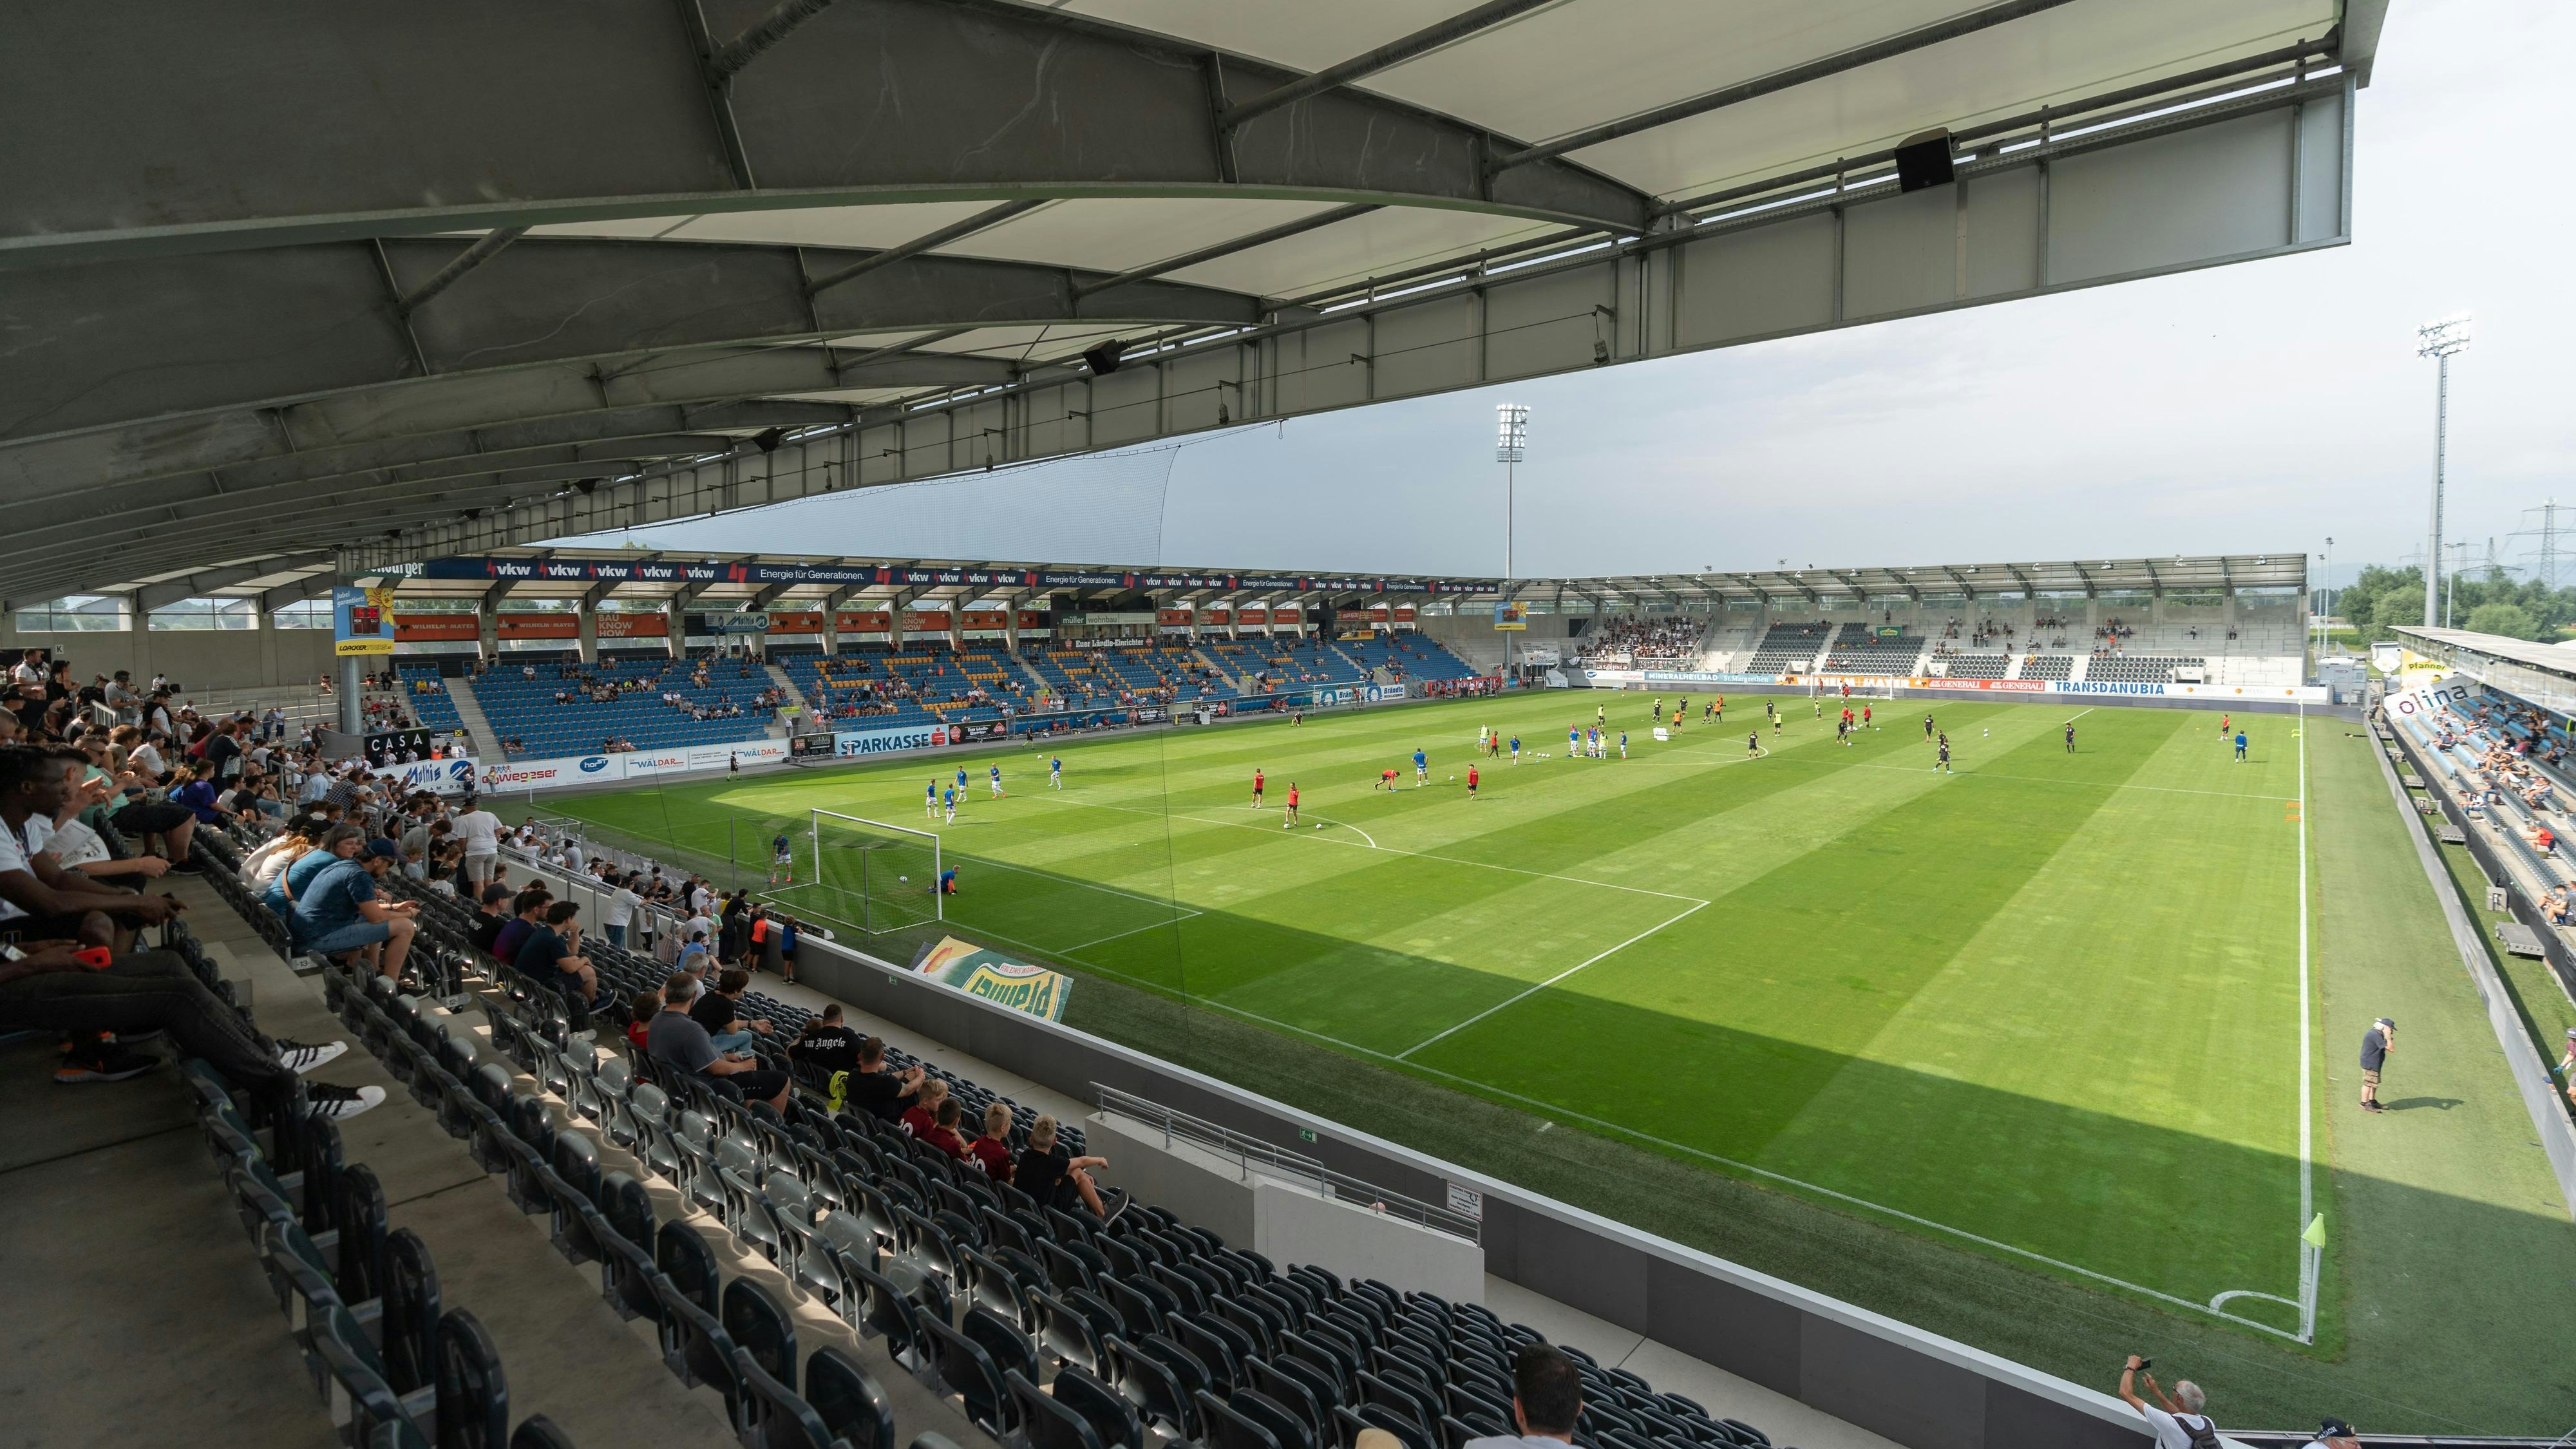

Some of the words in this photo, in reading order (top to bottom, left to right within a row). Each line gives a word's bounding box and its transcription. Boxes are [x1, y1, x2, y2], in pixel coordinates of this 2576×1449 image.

[497, 563, 531, 575] vkw
[549, 564, 580, 576] vkw
[598, 565, 627, 577] vkw
[643, 566, 672, 578] vkw
[687, 567, 714, 578] vkw
[761, 570, 793, 579] Energie
[795, 570, 807, 578] für
[808, 571, 864, 580] Generationen.
[908, 572, 929, 582] vkw
[939, 573, 959, 582] vkw
[969, 573, 988, 583] vkw
[998, 574, 1016, 583] vkw
[1046, 575, 1068, 583] Energie
[1146, 578, 1160, 586] vkw
[1168, 578, 1182, 587] vkw
[1189, 578, 1202, 587] vkw
[598, 614, 620, 622] BAU
[1063, 616, 1084, 624] müller
[1088, 616, 1117, 624] wohnbau
[598, 629, 625, 637] HOW
[1092, 638, 1144, 647] Ländle-Einrichter
[2409, 662, 2445, 670] pfanner
[2002, 681, 2043, 690] GENERALI
[2056, 682, 2164, 695] TRANSDANUBIA
[2399, 685, 2469, 714] olina
[372, 734, 422, 752] CASA
[841, 733, 929, 755] SPARKASSE
[743, 748, 777, 757] WÄLDAR
[638, 758, 676, 768] WÄLDAR
[406, 763, 441, 787] Mathis
[815, 1037, 846, 1050] Angels
